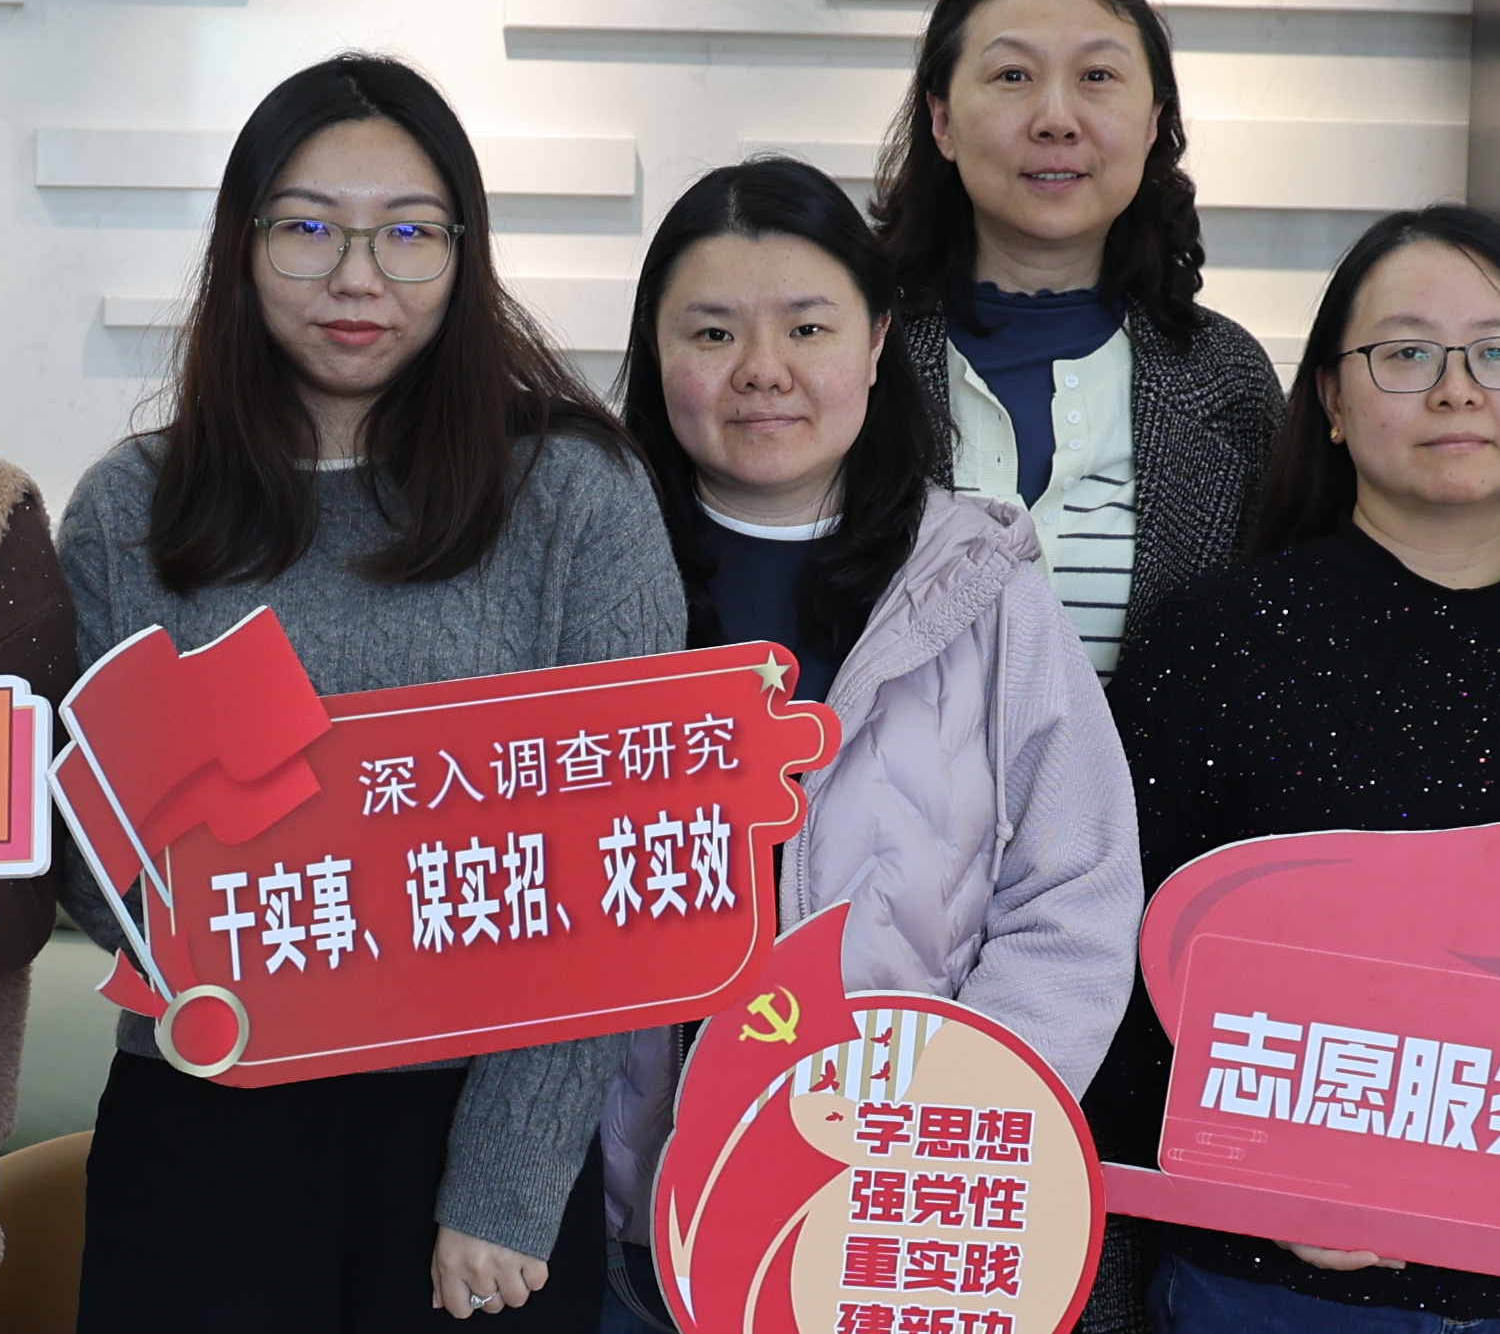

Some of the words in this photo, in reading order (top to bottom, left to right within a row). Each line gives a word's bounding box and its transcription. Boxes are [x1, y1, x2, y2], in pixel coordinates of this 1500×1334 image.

[358, 713, 739, 817] 深入调查研究
[855, 1102, 1034, 1164] 学思想
[850, 1170, 1027, 1230] 强党性
[842, 1235, 1021, 1297] 重实践
